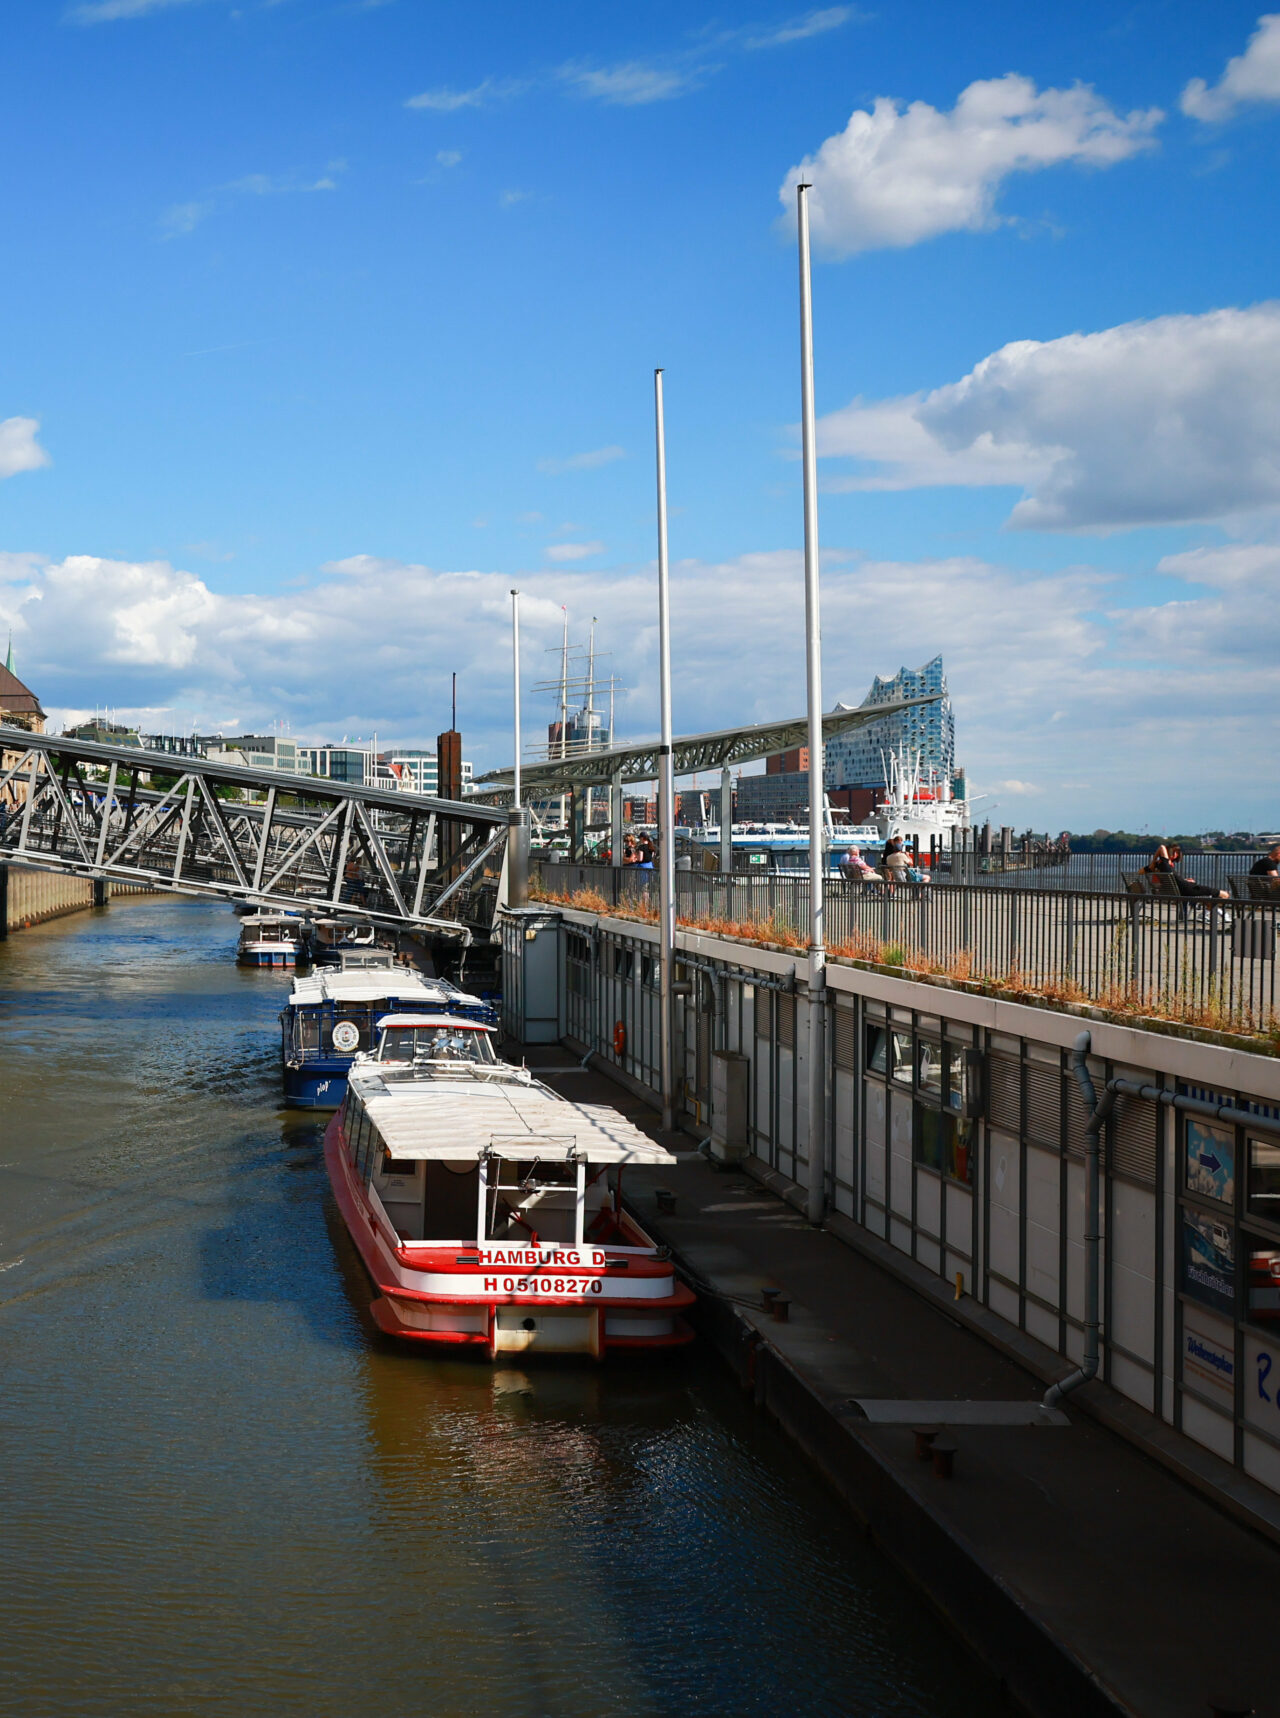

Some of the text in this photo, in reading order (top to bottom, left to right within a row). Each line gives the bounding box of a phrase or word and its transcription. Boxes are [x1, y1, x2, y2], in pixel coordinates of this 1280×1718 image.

[479, 1250, 605, 1265] HAMBURG D
[484, 1278, 603, 1294] H 05108270
